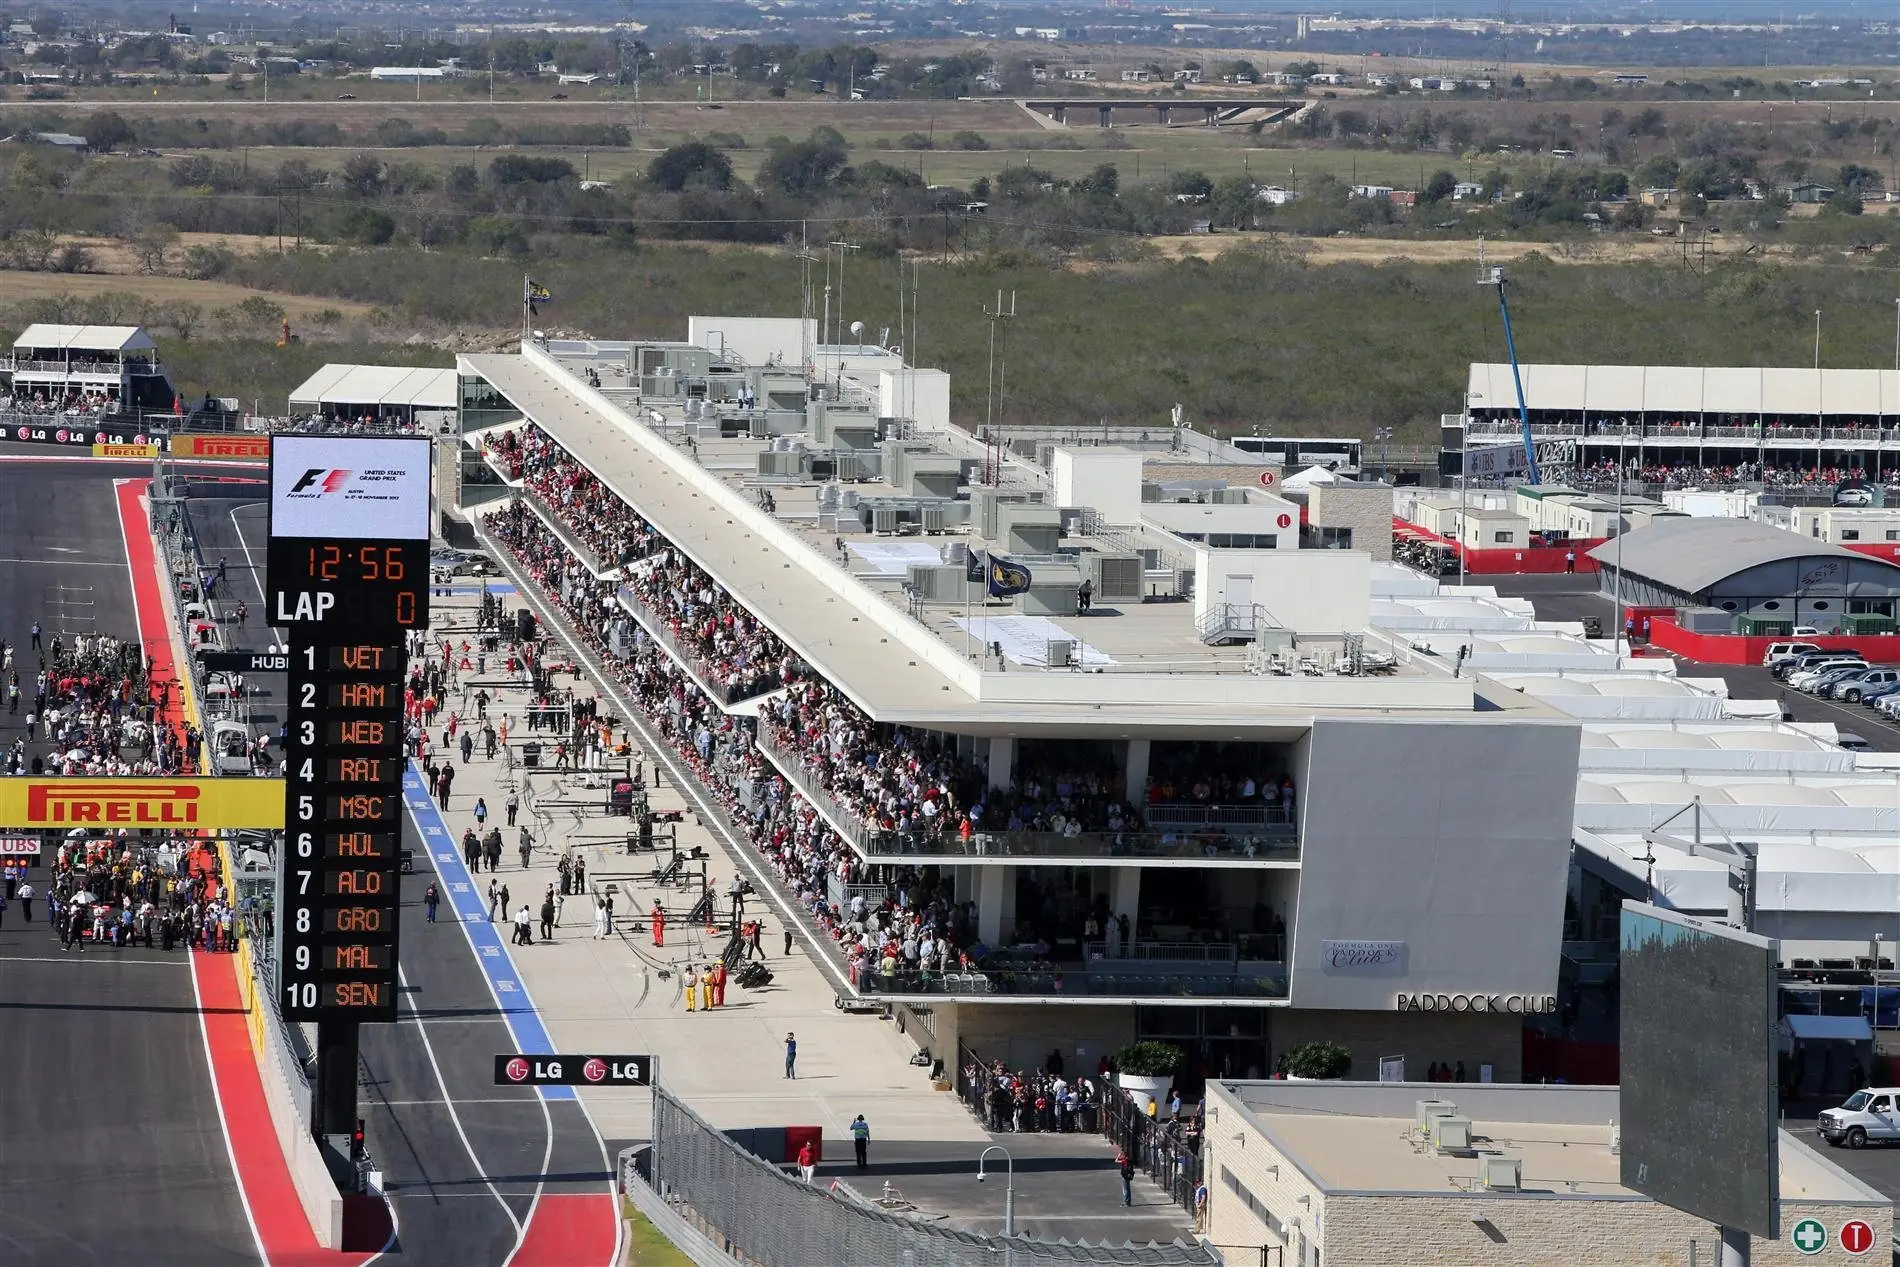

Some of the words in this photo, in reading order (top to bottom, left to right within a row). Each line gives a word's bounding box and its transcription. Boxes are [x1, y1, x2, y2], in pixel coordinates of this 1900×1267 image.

[32, 430, 46, 439] LG
[70, 433, 84, 442] LG
[109, 435, 123, 444] LG
[148, 437, 161, 446] LG
[193, 437, 269, 456] PIREL
[104, 445, 147, 456] PIRELLI
[277, 591, 335, 621] LAP
[397, 592, 415, 624] 0
[304, 646, 315, 671] 1
[343, 647, 383, 670] VET
[301, 683, 316, 708] 2
[342, 685, 384, 707] HAM
[300, 720, 315, 746] 3
[341, 722, 384, 745] WEB
[299, 757, 314, 782] 4
[340, 759, 380, 782] RAI
[28, 785, 201, 822] PIRELLI
[299, 795, 314, 821] 5
[340, 797, 382, 820] MSC
[2, 838, 38, 852] UBS
[298, 832, 312, 858] 6
[339, 834, 380, 857] HUL
[297, 870, 311, 895] 7
[338, 871, 380, 895] ALO
[296, 907, 311, 933] 8
[337, 909, 380, 931] GRO
[296, 945, 310, 971] 9
[336, 946, 377, 969] MAL
[1331, 950, 1382, 968] Club
[1332, 949, 1395, 957] PADDOCK
[287, 982, 317, 1008] 10
[335, 984, 378, 1006] SEN
[1397, 994, 1500, 1013] PADDOCK
[1506, 995, 1557, 1014] CLUB
[535, 1062, 562, 1079] LG
[612, 1062, 639, 1079] LG
[1850, 1224, 1863, 1250] T
